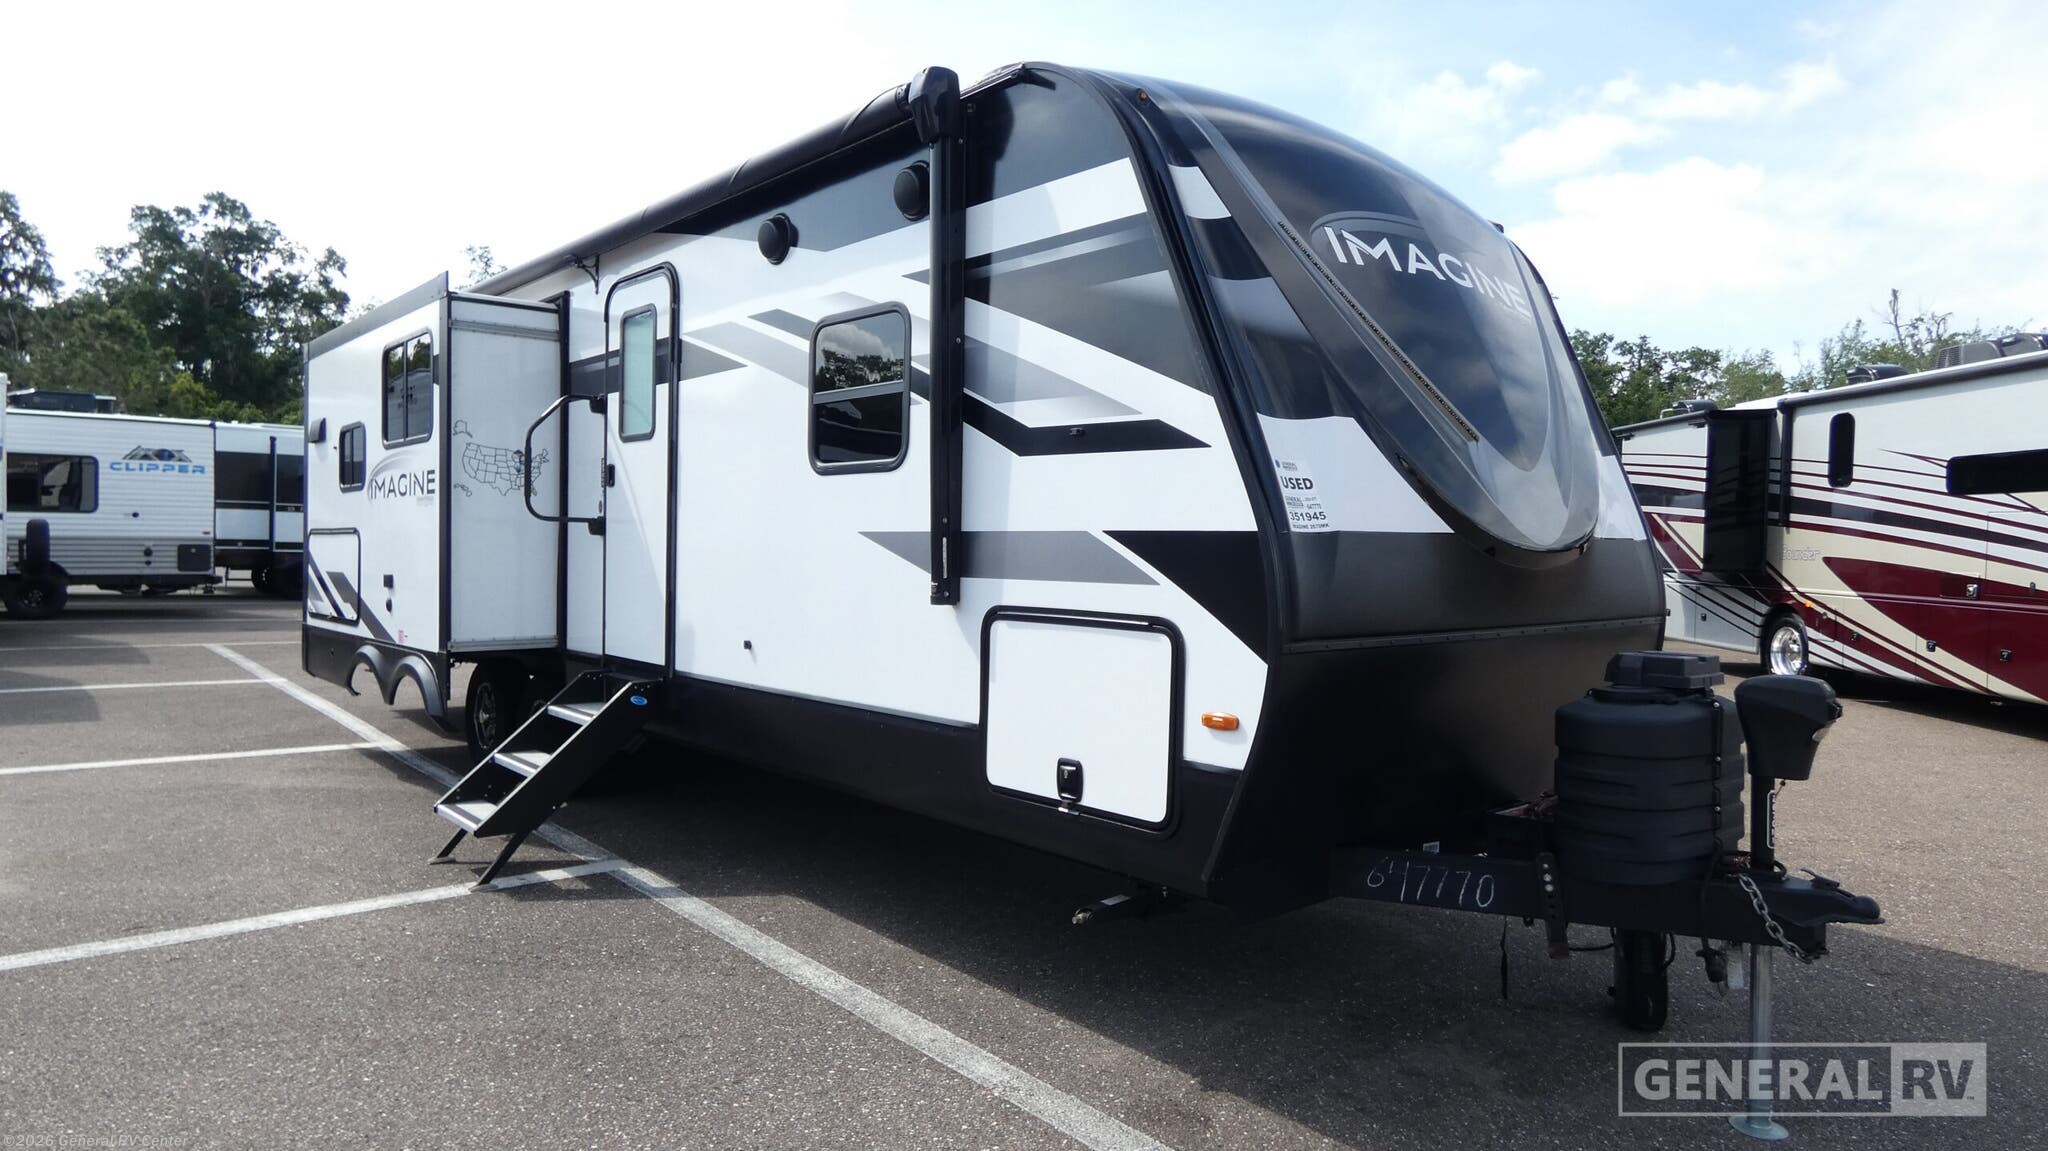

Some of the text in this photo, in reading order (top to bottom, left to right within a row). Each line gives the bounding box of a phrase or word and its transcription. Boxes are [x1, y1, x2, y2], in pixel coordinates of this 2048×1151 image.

[1324, 226, 1532, 319] IMAGINE
[109, 461, 206, 475] CLIPPER
[370, 469, 436, 500] IMAGINE
[1280, 476, 1314, 491] USED
[1289, 511, 1327, 522] 351945
